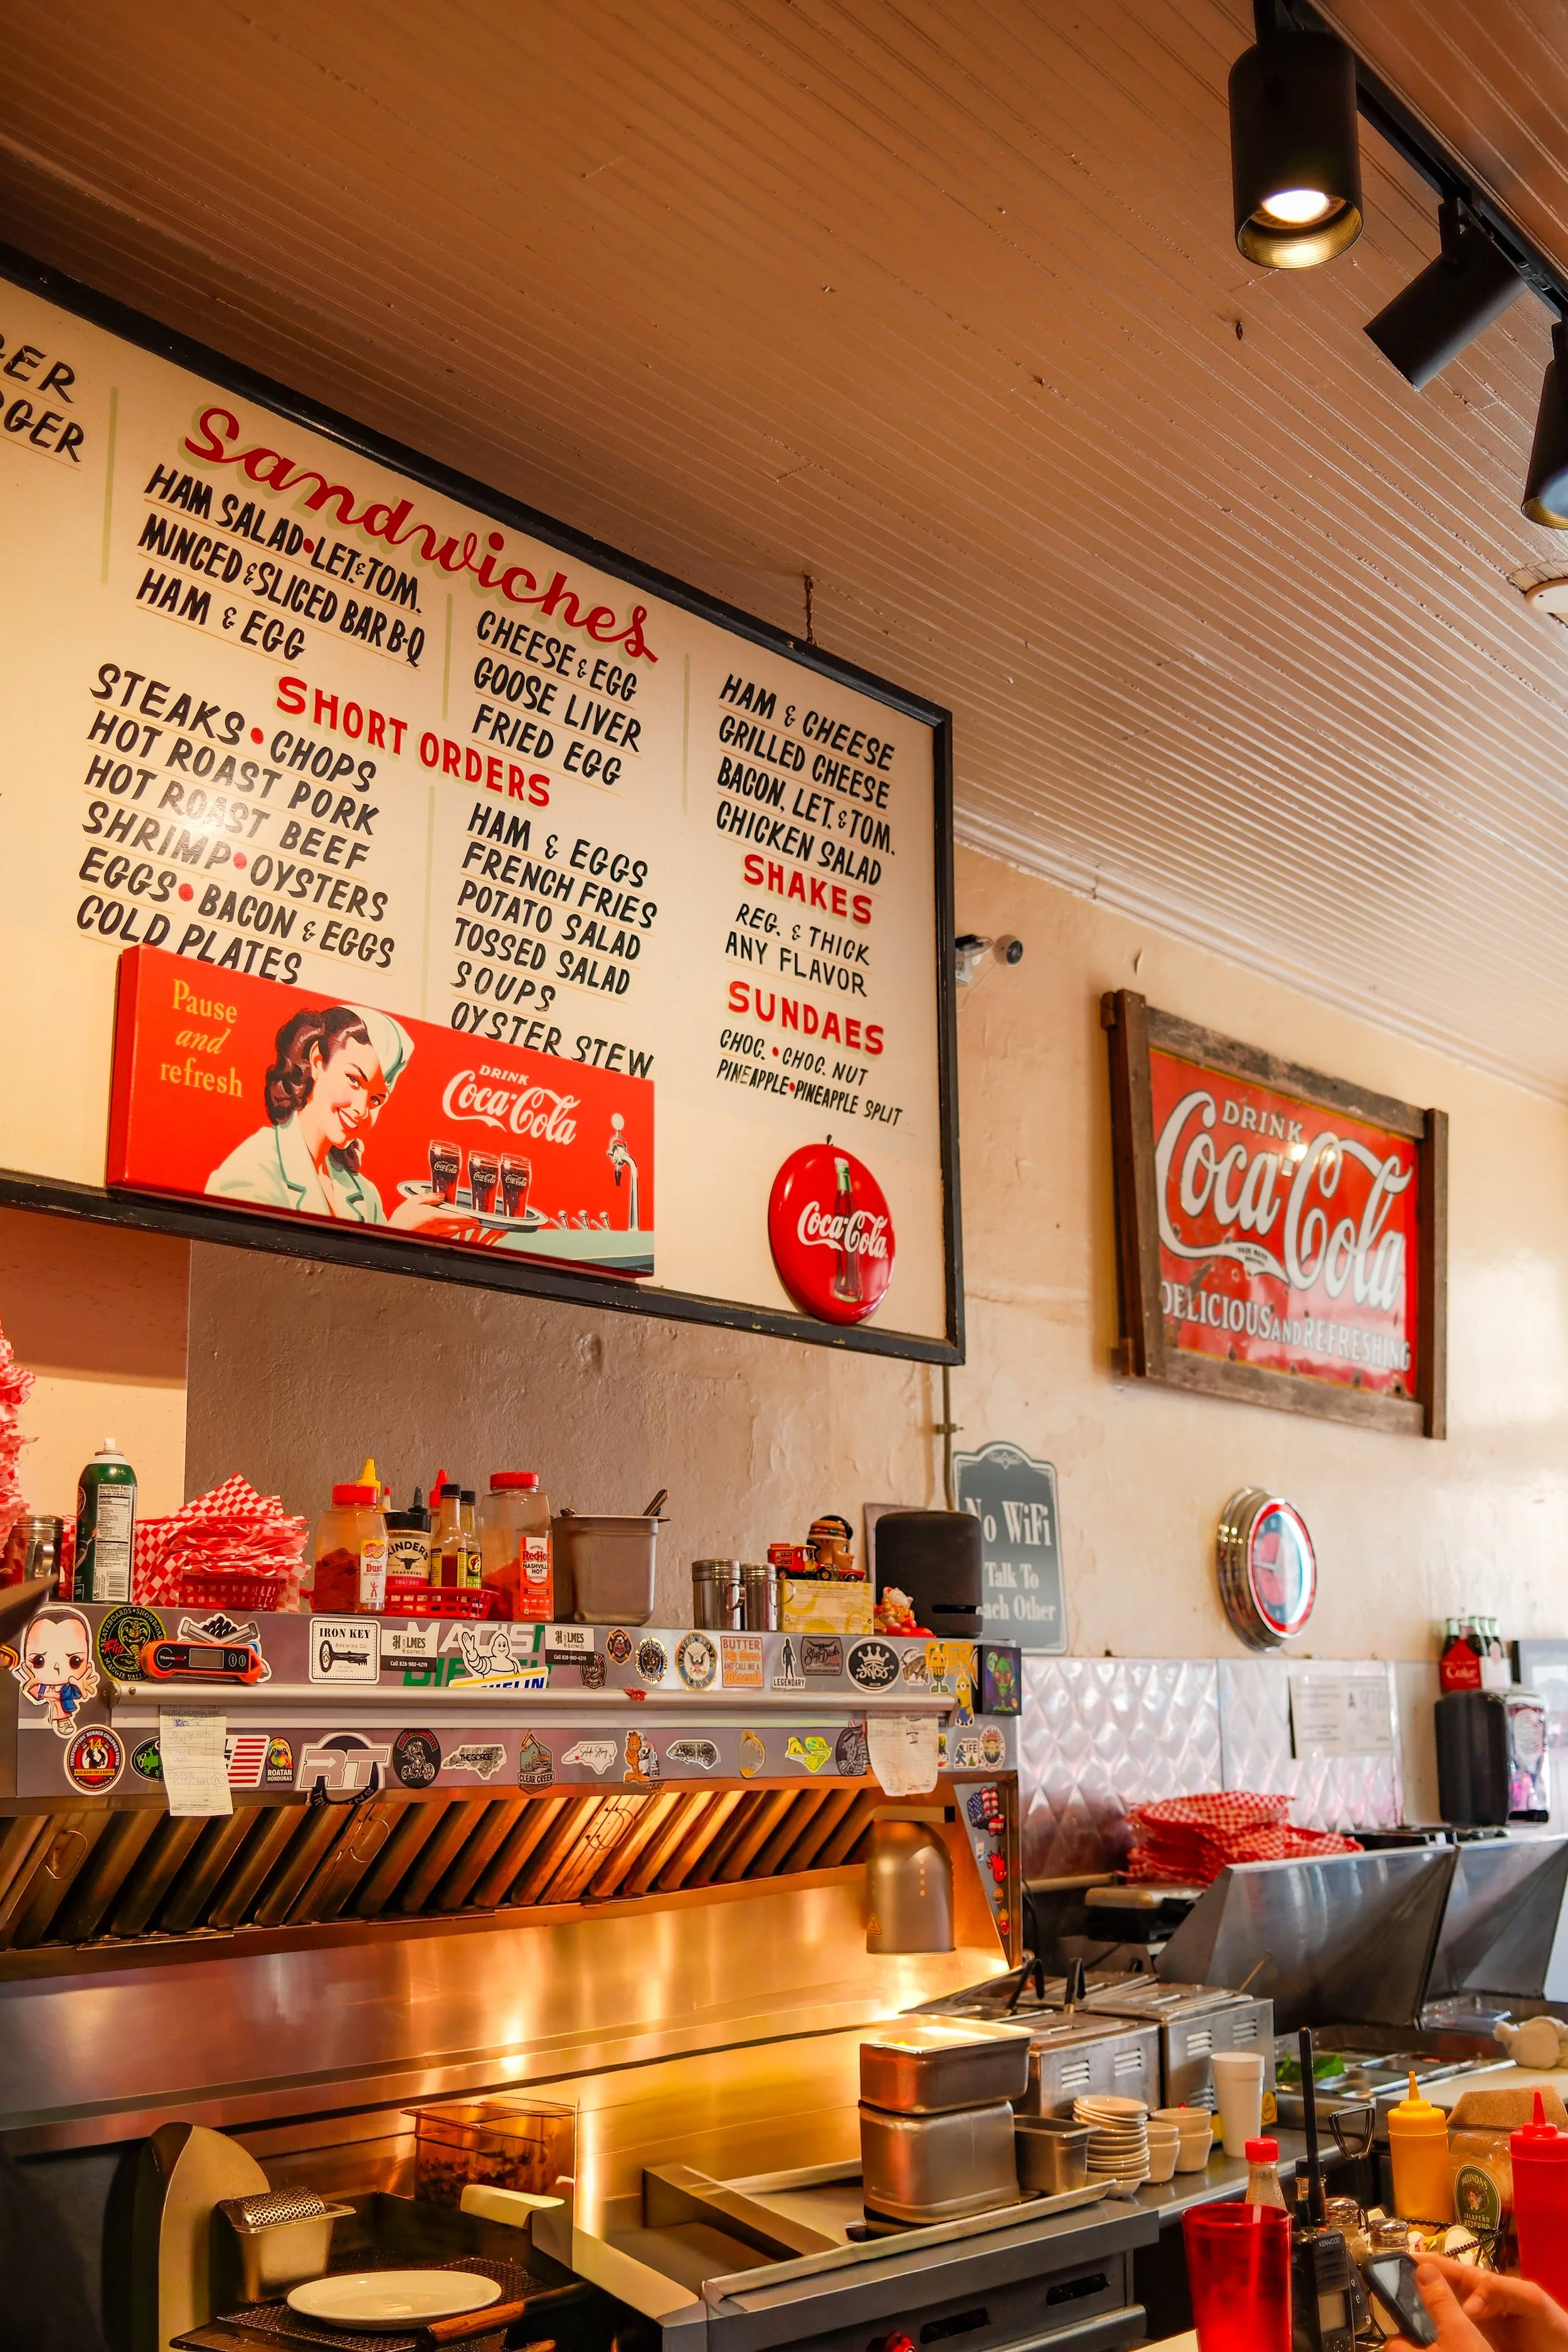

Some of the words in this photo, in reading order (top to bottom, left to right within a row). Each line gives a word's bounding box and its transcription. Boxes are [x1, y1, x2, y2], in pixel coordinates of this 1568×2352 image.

[0, 333, 75, 403] ER
[0, 389, 82, 462] GER
[144, 463, 213, 519] HAM
[215, 493, 304, 557] SALAD
[310, 536, 362, 584] LET.
[362, 556, 423, 614] TOM.
[184, 408, 659, 663] Sandwiches
[135, 568, 212, 625] HAM
[223, 607, 237, 630] &
[240, 610, 306, 661] EGG
[137, 512, 243, 584] MINCED
[250, 561, 338, 623] SLICED
[339, 599, 388, 647] BAR
[386, 618, 425, 668] B-Q
[476, 610, 576, 677] CHEESE
[577, 658, 588, 679] &
[590, 658, 637, 702] EGG
[89, 662, 246, 746] STEAKS
[269, 729, 378, 793] CHOPS
[474, 657, 559, 716] GOOSE
[564, 694, 642, 753] LIVER
[719, 673, 778, 720] HAM
[784, 705, 797, 728] &
[802, 710, 896, 771] CHEESE
[87, 709, 164, 759] HOT
[164, 736, 283, 800] ROAST
[287, 780, 380, 836] PORK
[276, 676, 408, 756] SHORT
[419, 731, 551, 808] ORDERS
[471, 704, 554, 759] FRIED
[563, 741, 622, 785] EGG
[719, 715, 806, 772] GRILLED
[812, 753, 891, 810] CHEESE
[83, 754, 158, 800] HOT
[157, 780, 272, 839] ROAST
[279, 820, 371, 870] BEEF
[717, 756, 787, 813] BACON,
[792, 788, 836, 830] LET.
[838, 810, 847, 829] &
[849, 809, 896, 856] TOM.
[81, 800, 233, 871] SHRIMP
[250, 854, 389, 923] OYSTERS
[467, 802, 531, 852] HAM
[546, 834, 559, 859] &
[569, 839, 649, 889] EGGS
[716, 800, 815, 862] CHICKEN
[817, 840, 882, 886] SALAD
[78, 846, 178, 903] EGGS
[198, 883, 298, 940] BACON
[303, 920, 317, 943] &
[319, 919, 396, 969] EGGS
[461, 841, 576, 902] FRENCH
[577, 881, 659, 930] FRIES
[743, 854, 873, 925] SHAKES
[77, 894, 171, 947] COLD
[176, 923, 304, 985] PLATES
[457, 879, 553, 934] POTATO
[559, 913, 641, 961] SALAD
[735, 903, 781, 937] REG.
[792, 924, 802, 941] &
[809, 926, 871, 967] THICK
[450, 960, 557, 1012] SOUPS
[454, 917, 547, 971] TOSSED
[556, 950, 632, 996] SALAD
[725, 931, 768, 965] ANY
[779, 947, 868, 998] FLAVOR
[172, 979, 238, 1024] Pause
[728, 980, 884, 1056] SUNDAES
[175, 1028, 231, 1056] and
[450, 1001, 563, 1057] OYSTER
[570, 1035, 655, 1079] STEW
[719, 1029, 767, 1061] CHOC.
[781, 1046, 827, 1076] CHOC.
[832, 1061, 869, 1087] NUT
[160, 1057, 243, 1098] refresh
[442, 1069, 581, 1145] Coca-Cola
[479, 1064, 530, 1086] DRINK
[716, 1059, 791, 1096] PINEAPPLE
[793, 1079, 860, 1115] PINEAPPLE
[863, 1099, 904, 1127] SPLIT
[1221, 1099, 1303, 1143] DRINK
[797, 1200, 889, 1259] Coca-Cola
[1155, 1089, 1413, 1311] Coca-Cola
[1269, 1317, 1303, 1345] AND
[1303, 1318, 1412, 1373] REFRESHING
[1002, 1500, 1052, 1547] WiFi
[366, 1564, 383, 1572] Dust
[984, 1561, 1017, 1589] Talk
[1020, 1562, 1039, 1590] To
[100, 1608, 132, 1647] SKATEBOARDS
[136, 1608, 163, 1640] SNOWBOAR
[319, 1628, 346, 1638] IRON
[349, 1629, 371, 1639] KEY
[978, 1594, 1010, 1621] ach
[1013, 1594, 1057, 1621] Other
[104, 1657, 126, 1679] MAGGIE
[679, 1634, 695, 1666] UNITED
[723, 1639, 760, 1650] BUTTER
[686, 1677, 709, 1688] NAVY
[773, 1678, 805, 1687] LEGENDARY
[89, 1738, 103, 1750] 14
[460, 1754, 470, 1762] THE
[471, 1753, 492, 1761] GORGE
[519, 1774, 536, 1783] CLEAR
[536, 1772, 554, 1784] CREEK
[963, 1744, 977, 1753] LIFE
[1461, 2173, 1488, 2190] MELINDA'S
[1318, 2236, 1340, 2248] KENWOOD
[1464, 2212, 1490, 2223] JALAPEÑO
